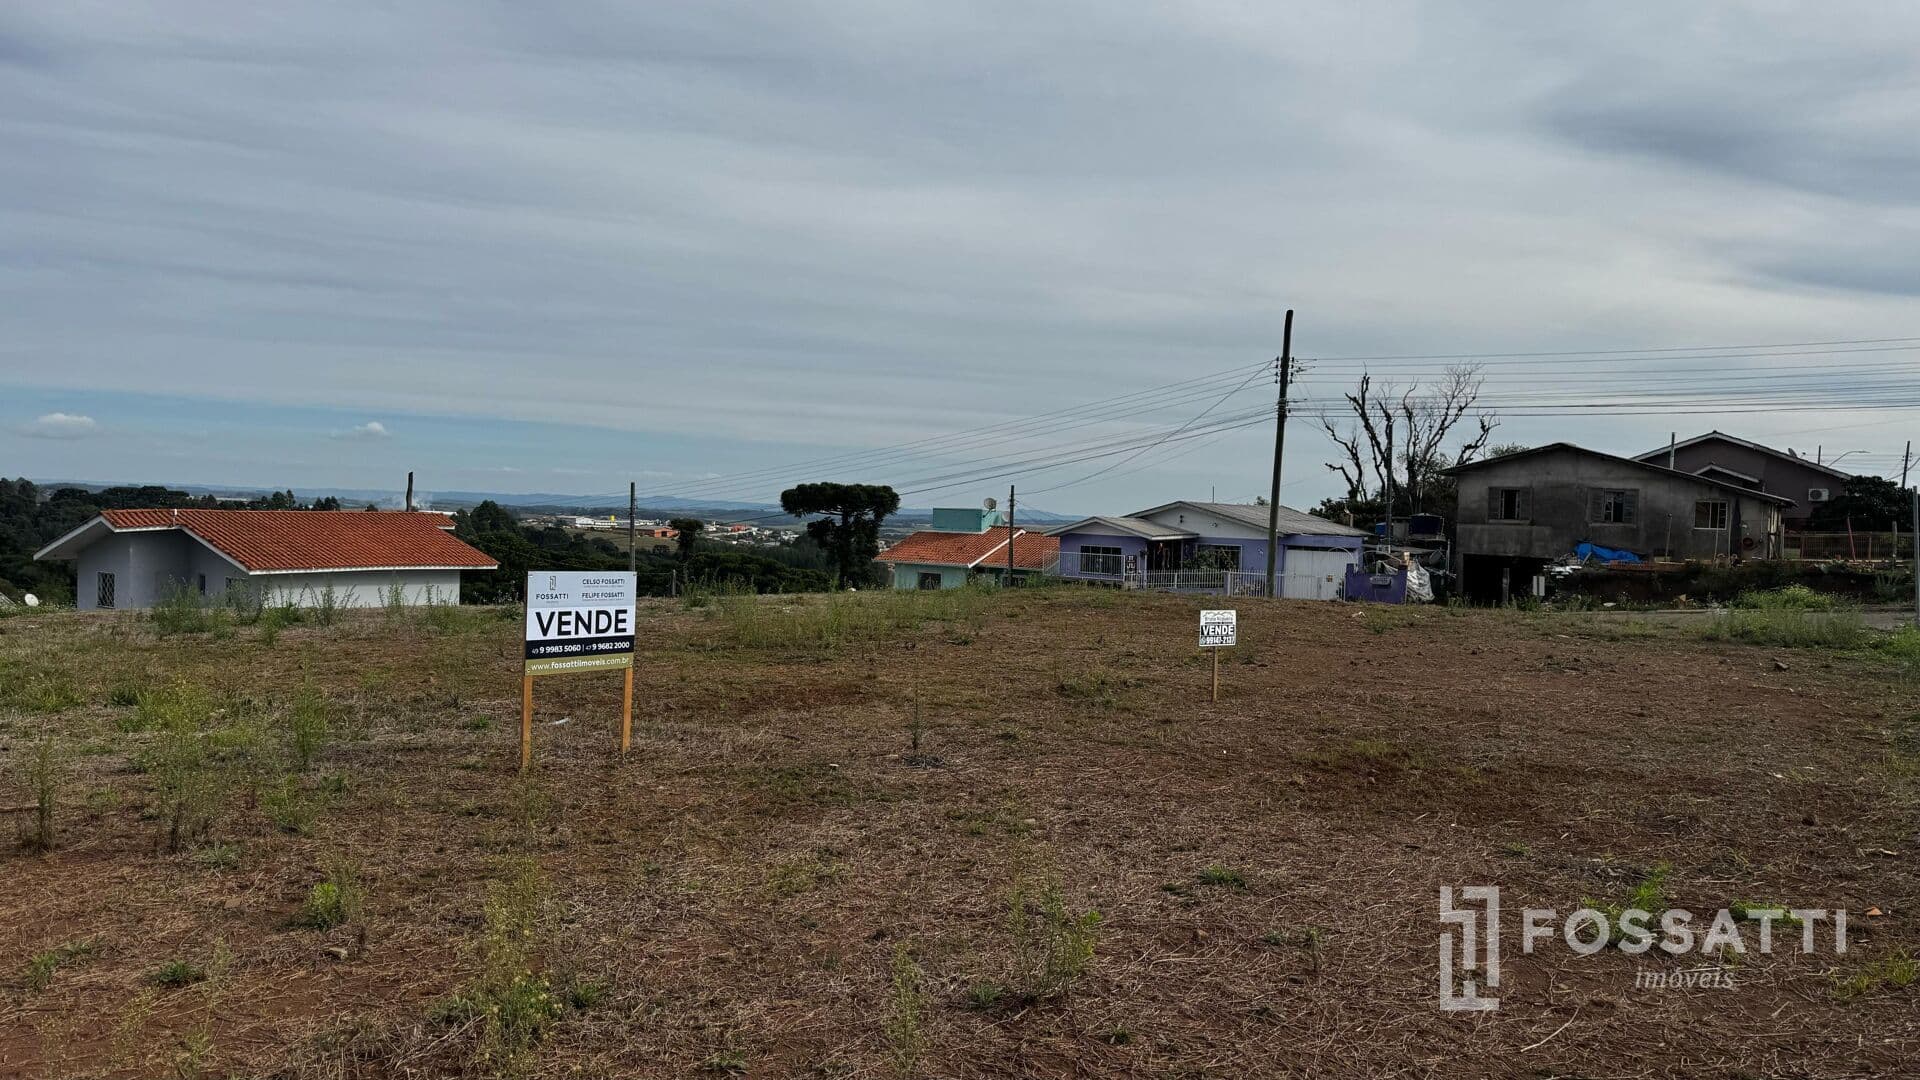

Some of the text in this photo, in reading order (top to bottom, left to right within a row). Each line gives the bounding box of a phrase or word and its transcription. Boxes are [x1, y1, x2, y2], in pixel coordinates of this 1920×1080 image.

[535, 609, 628, 637] VENDE
[1202, 625, 1234, 635] VENDE
[564, 644, 581, 652] 5060
[614, 641, 630, 649] 2000
[531, 657, 629, 671] www.fossattiimoveis.com.br
